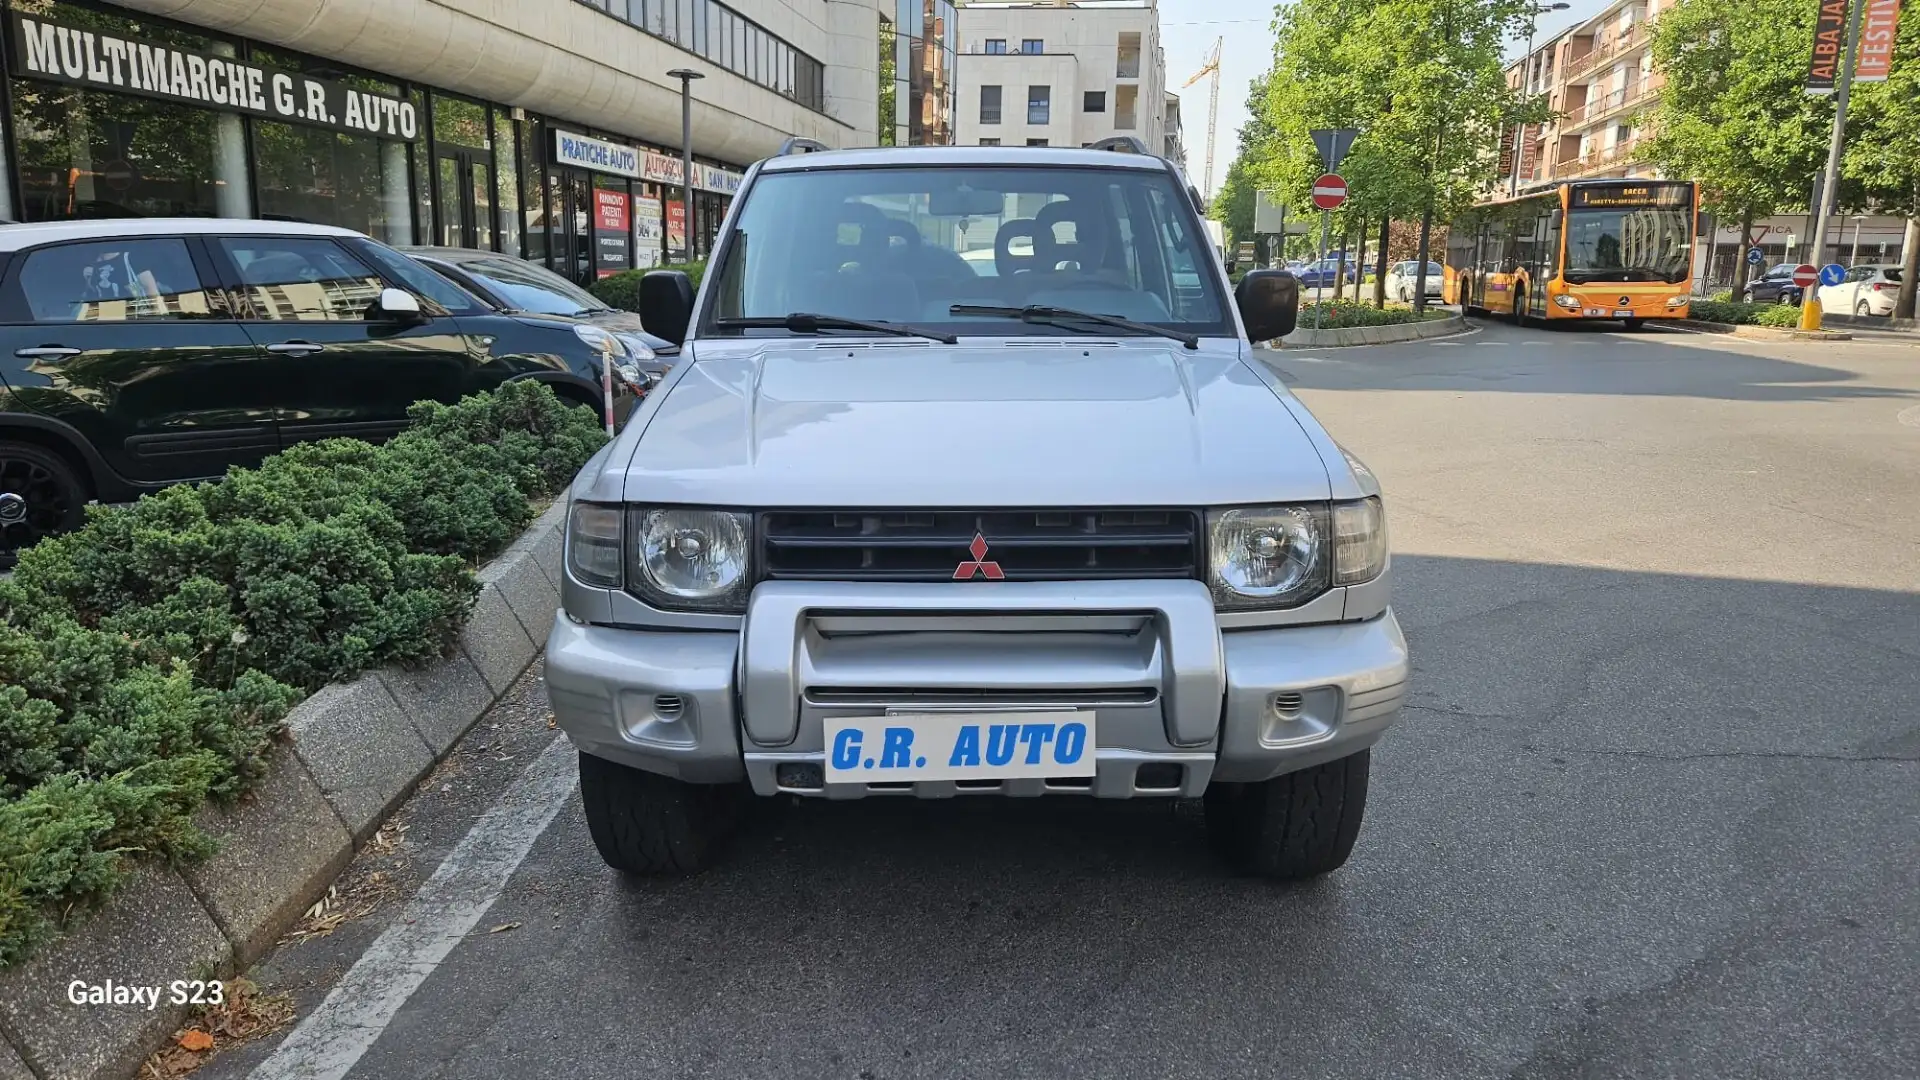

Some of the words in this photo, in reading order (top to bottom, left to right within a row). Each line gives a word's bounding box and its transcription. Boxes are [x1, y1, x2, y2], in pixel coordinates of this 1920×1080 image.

[1820, 0, 1845, 26] JA
[1812, 29, 1841, 79] ALBA
[21, 18, 267, 111] MULTIMARCHE
[272, 73, 337, 124] G.R.
[345, 90, 417, 139] AUTO
[561, 137, 608, 166] PRATICHE
[610, 150, 636, 172] AUTO
[644, 153, 700, 188] AUTOSCUA
[708, 171, 724, 188] SAN
[601, 205, 622, 218] PATENTI
[831, 728, 927, 770] G.R.
[948, 722, 1087, 767] AUTO
